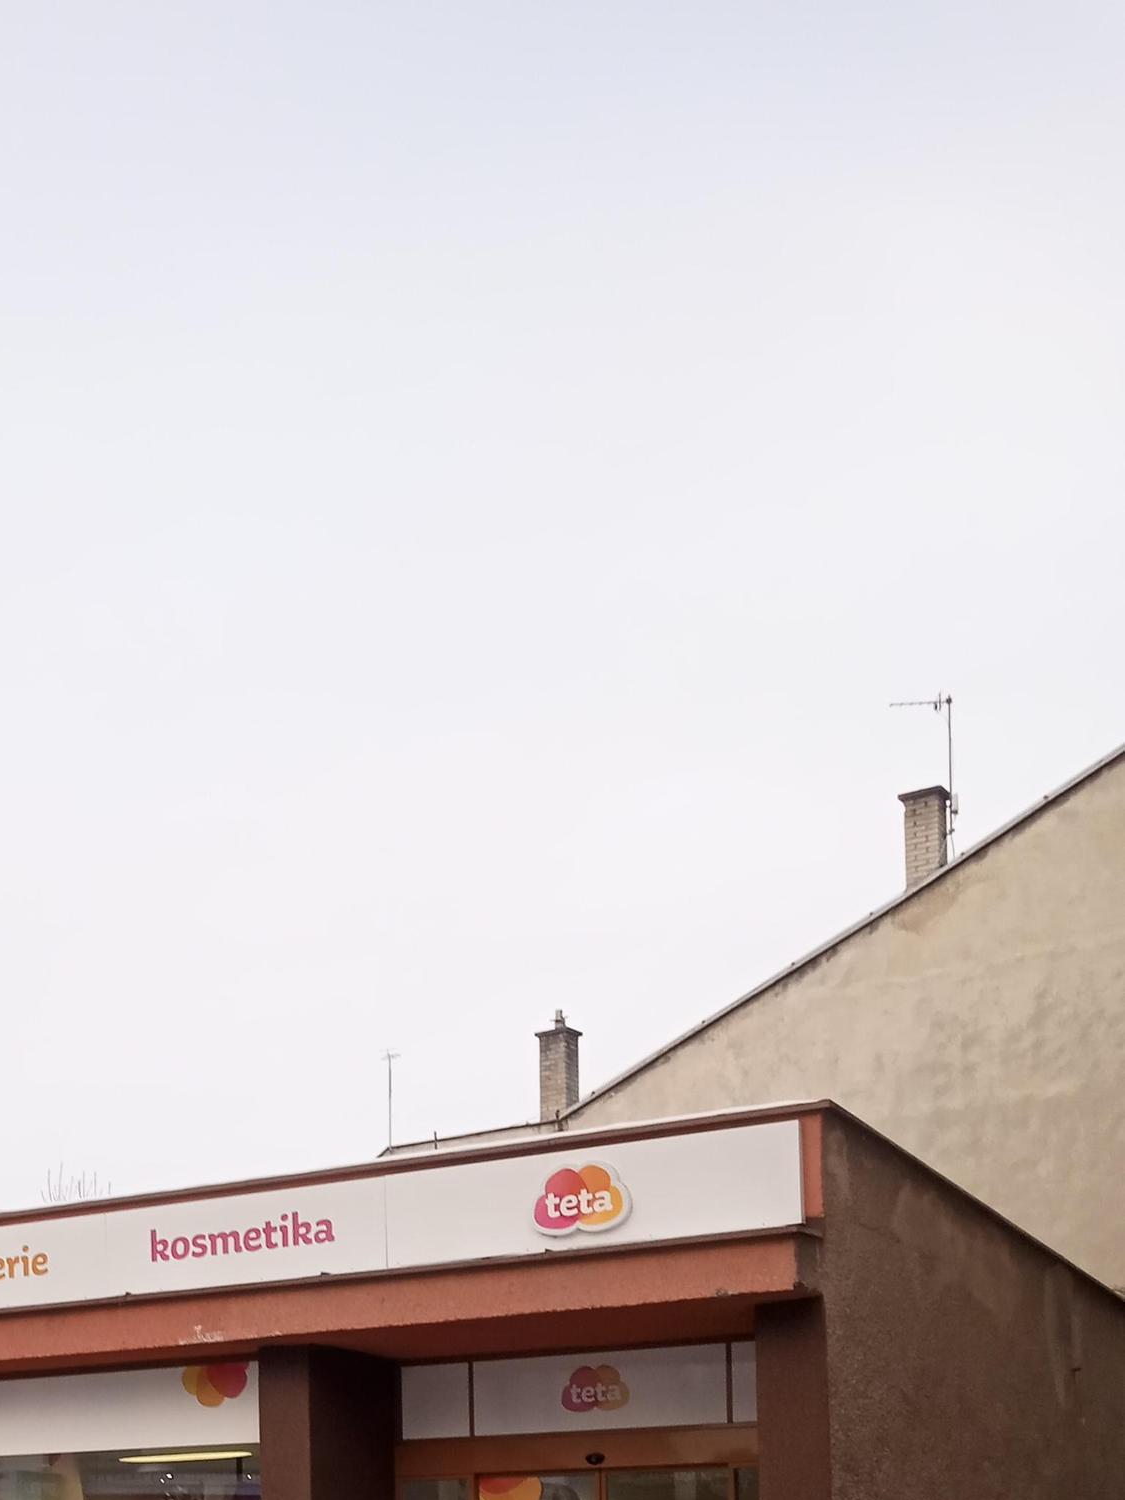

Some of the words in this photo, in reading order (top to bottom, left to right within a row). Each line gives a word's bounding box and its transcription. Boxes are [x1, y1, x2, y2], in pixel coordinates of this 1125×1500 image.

[545, 1188, 613, 1218] teta
[150, 1211, 336, 1262] kosmetika
[570, 1382, 622, 1403] teta
